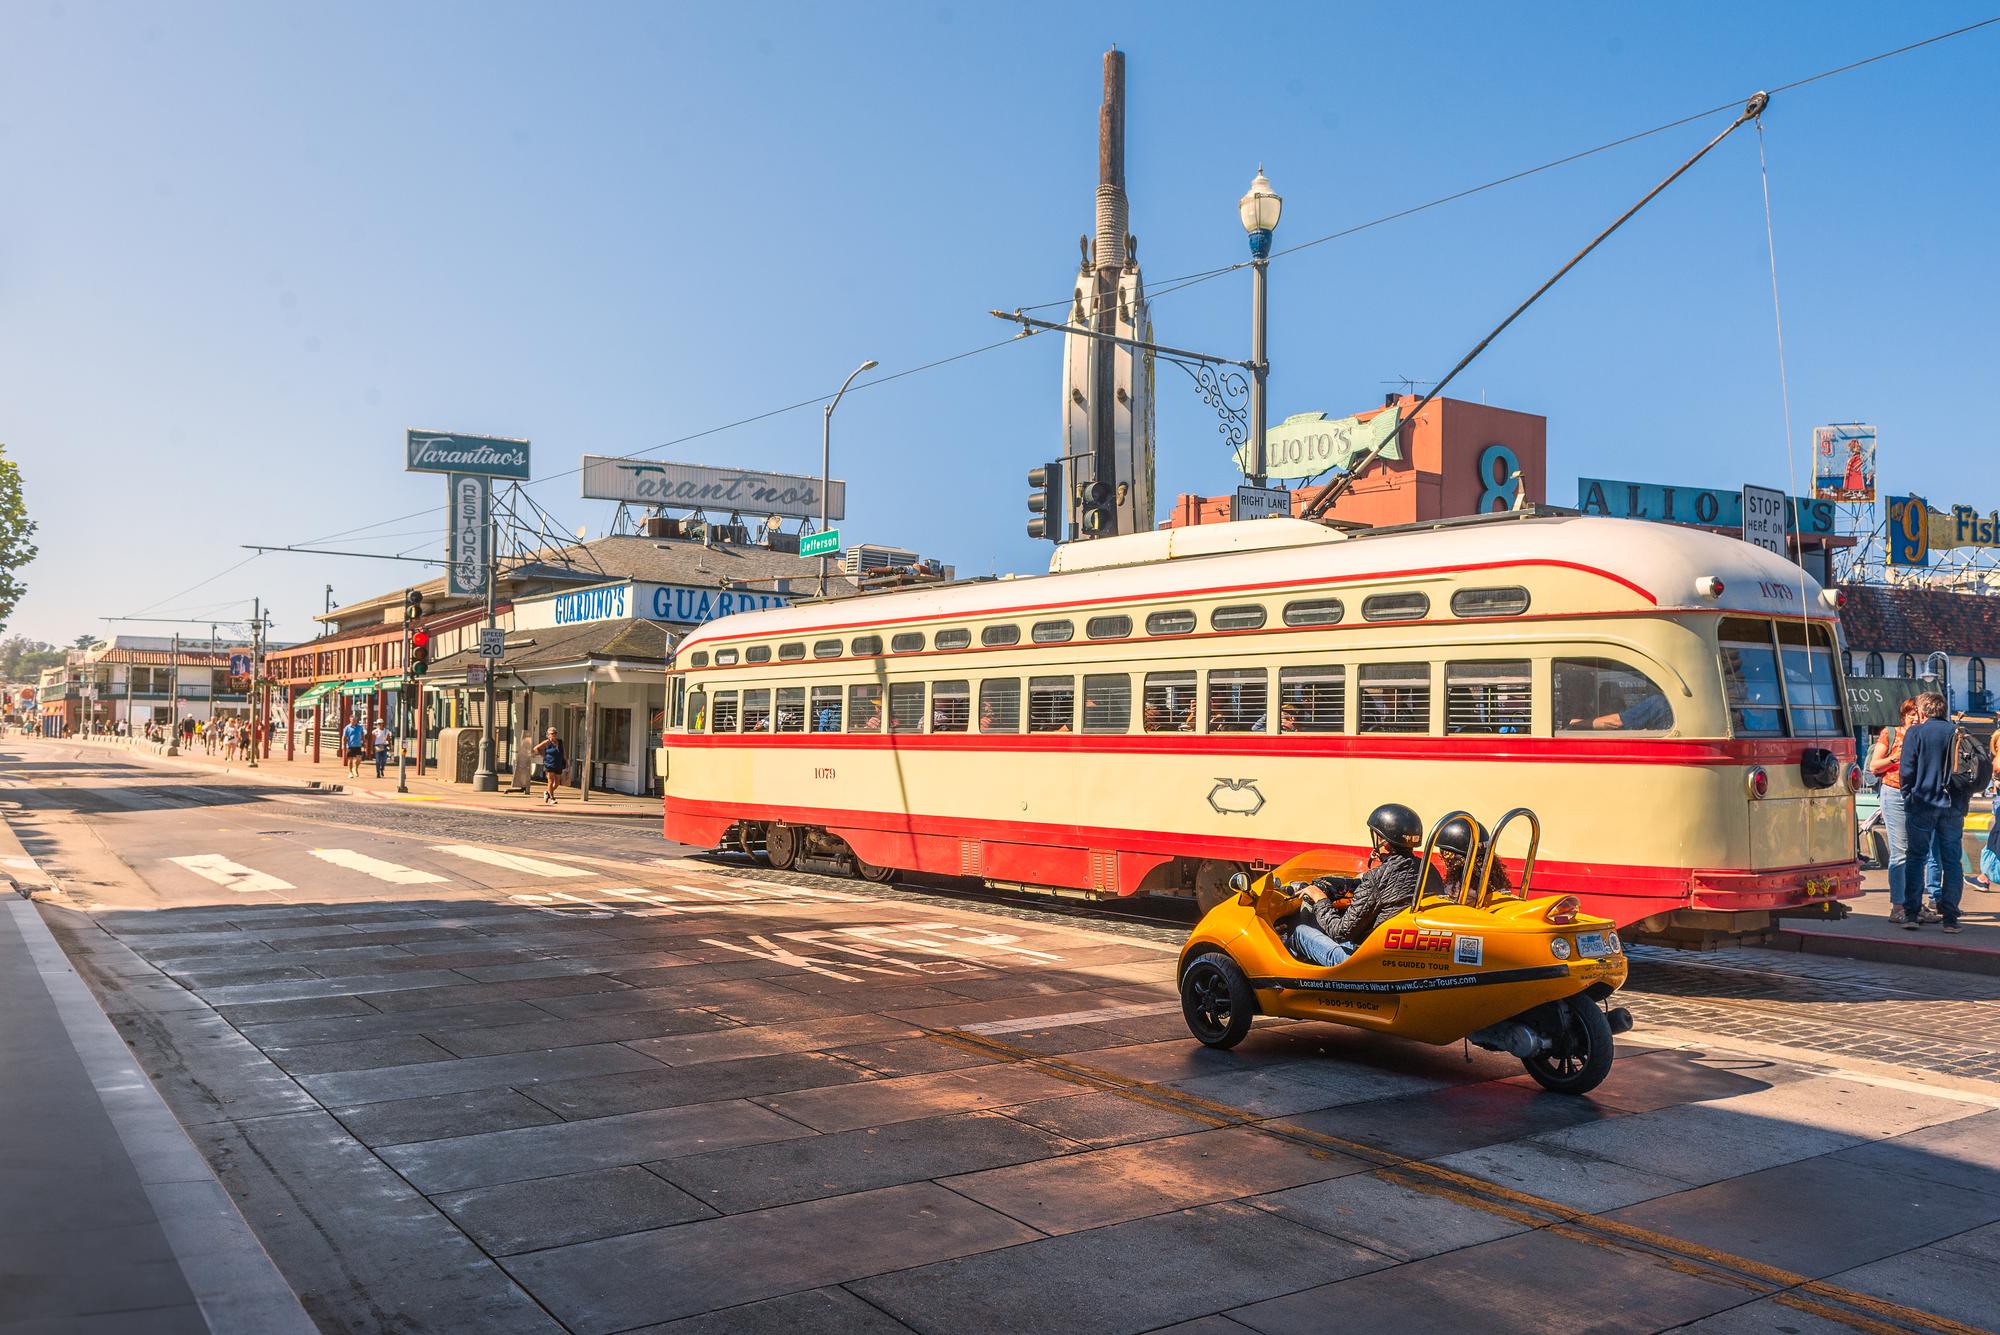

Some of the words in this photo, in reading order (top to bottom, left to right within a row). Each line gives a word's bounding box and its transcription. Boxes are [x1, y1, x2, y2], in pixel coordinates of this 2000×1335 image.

[412, 437, 527, 465] Tarantino's
[1266, 427, 1352, 467] LIOTO'S
[1478, 445, 1520, 514] 8
[1241, 495, 1264, 507] RIGHT
[1267, 496, 1287, 509] LANE
[1582, 481, 1833, 532] ALIO'S
[1749, 496, 1780, 516] STOP
[463, 484, 477, 584] RESTAURANT
[1748, 519, 1767, 532] HERE
[1772, 523, 1782, 534] ON
[1903, 499, 1928, 562] 9
[802, 538, 837, 552] Jefferson
[1758, 581, 1793, 600] 1079
[555, 586, 625, 624] GUARDINO'S
[483, 644, 501, 655] 20
[814, 767, 836, 780] 1079
[699, 922, 1070, 983] KEEP
[1397, 960, 1426, 969] GUIDED
[1428, 962, 1450, 970] TOUR
[1299, 980, 1324, 988] Located
[1332, 982, 1369, 990] Fisherman's
[1370, 983, 1389, 991] Wharf
